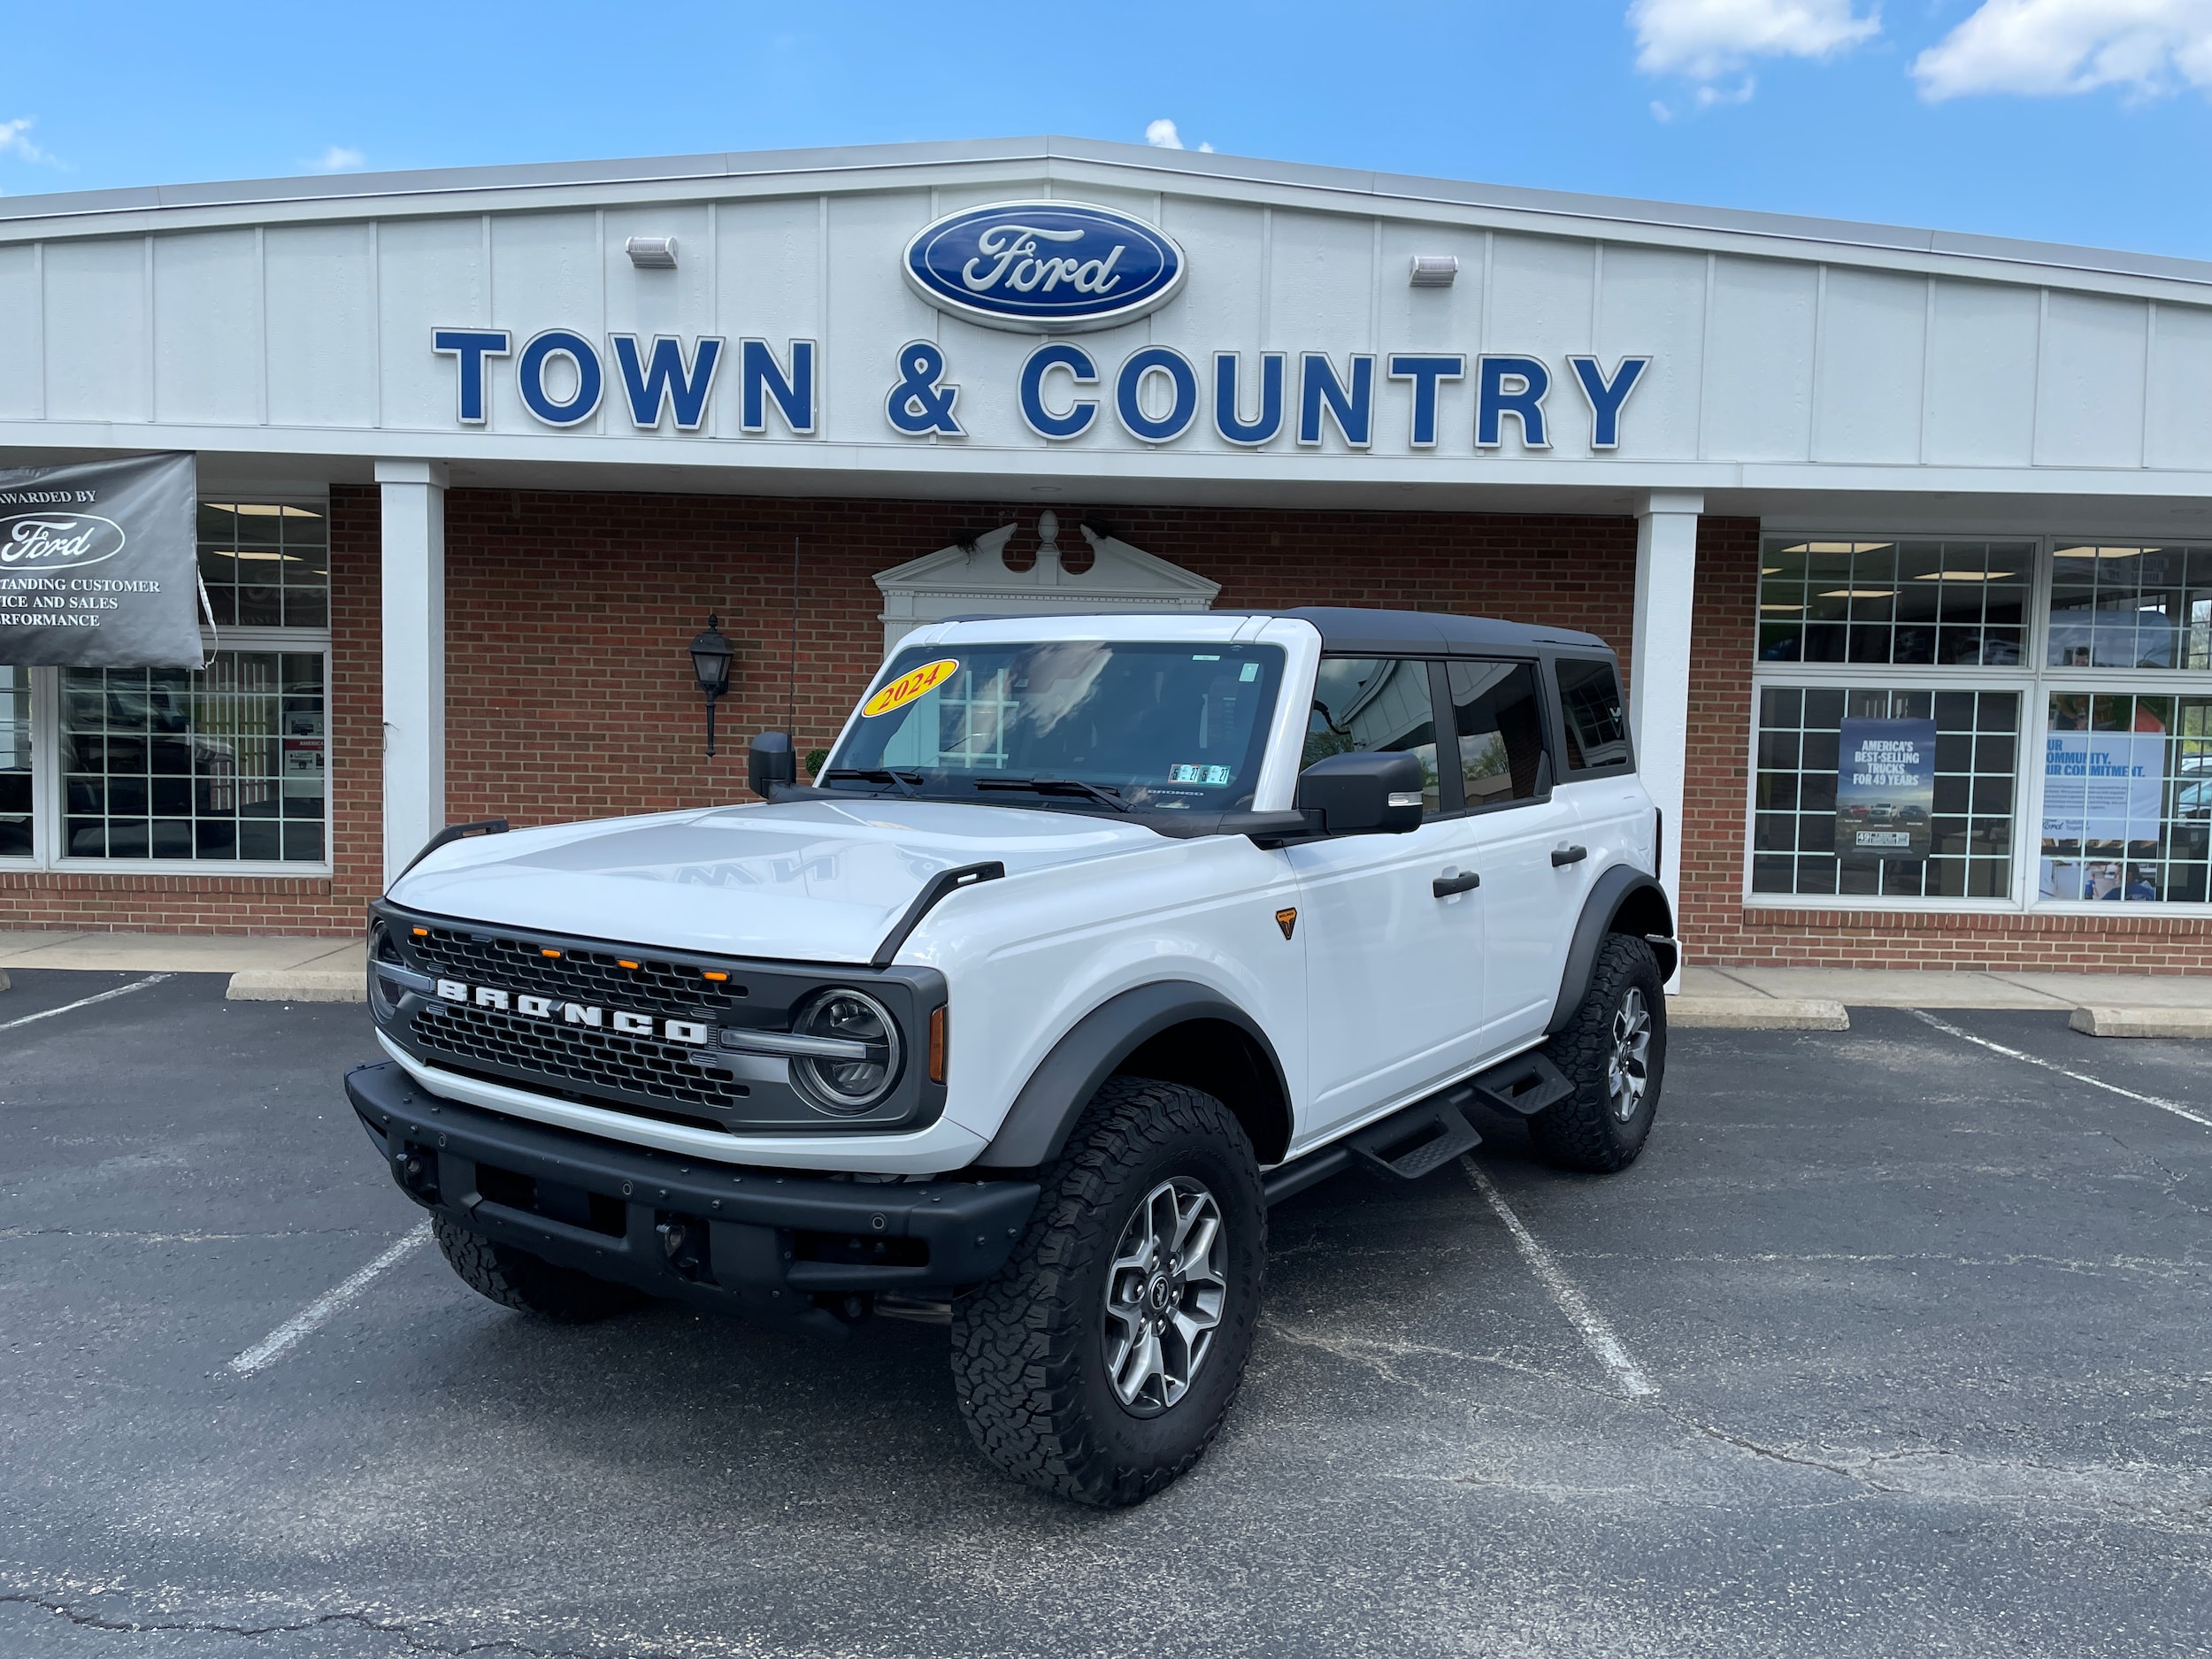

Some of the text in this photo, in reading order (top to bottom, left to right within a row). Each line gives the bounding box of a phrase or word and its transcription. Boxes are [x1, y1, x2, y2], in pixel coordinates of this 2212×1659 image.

[963, 225, 1126, 294] Ford
[431, 326, 1654, 450] TOWN & COUNTRY
[75, 490, 96, 503] BY
[2, 520, 95, 562] Ford
[71, 580, 161, 593] CUSTOMER
[0, 595, 119, 610] ICE AND SALES
[0, 613, 101, 627] RFORMANCE
[877, 664, 941, 711] 2024
[1862, 740, 1914, 752] AMERICA'S
[2047, 739, 2063, 751] UR
[1854, 751, 1920, 764] BEST-SELLING
[1867, 763, 1905, 774] TRUCKS
[2045, 764, 2062, 775] UR
[1853, 773, 1919, 786] FOR 49 YEARS
[437, 979, 707, 1044] BRONCO
